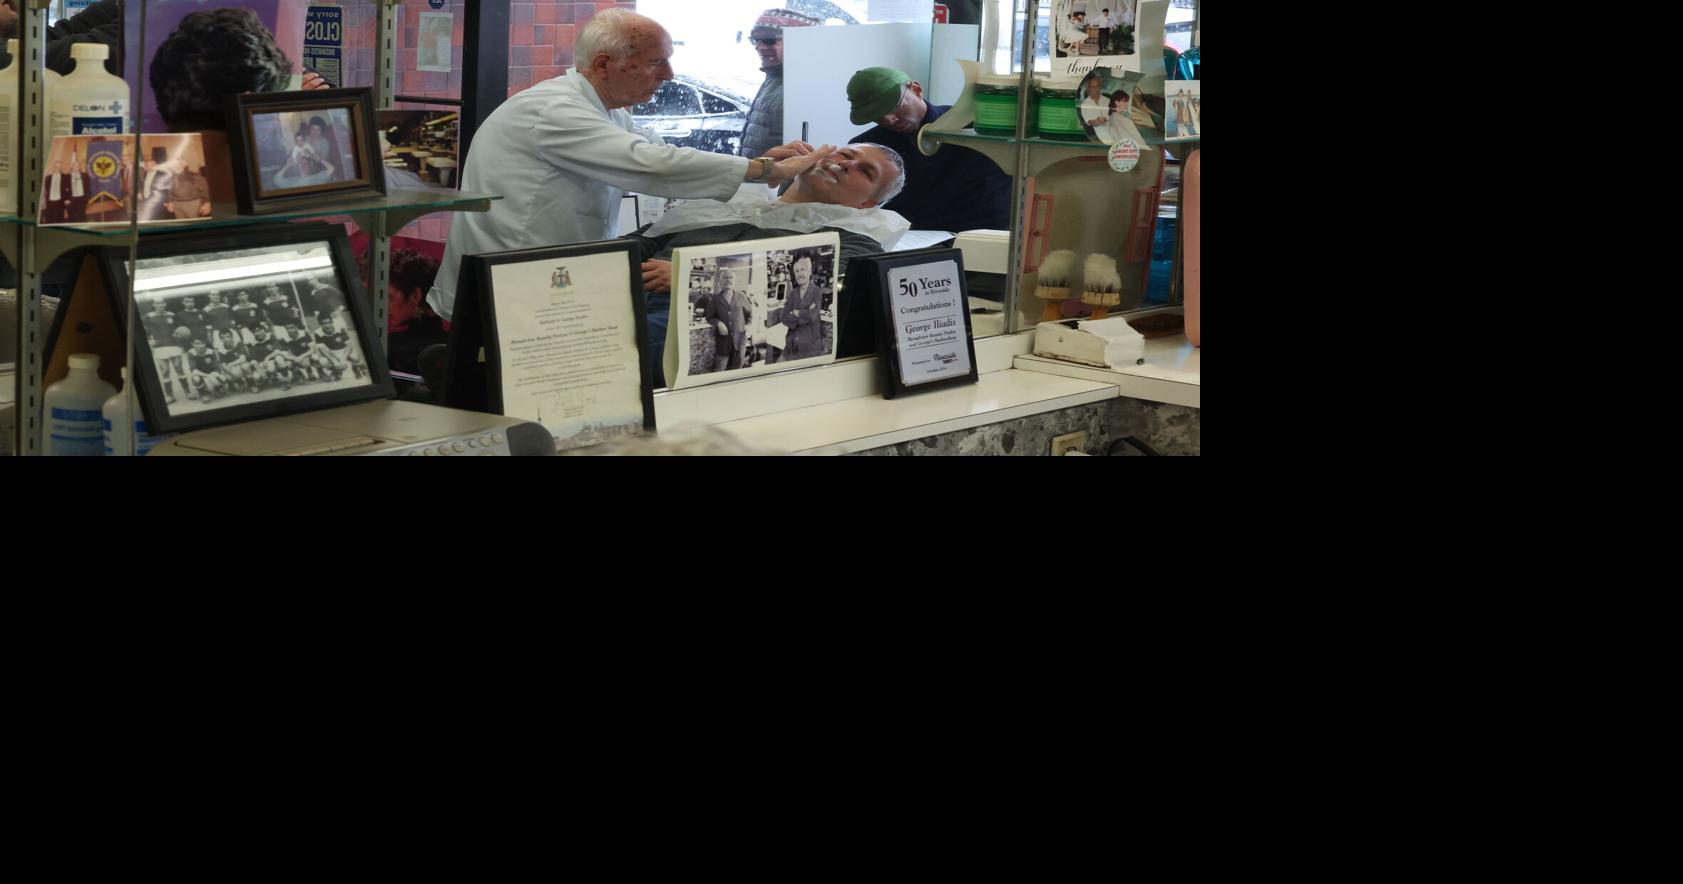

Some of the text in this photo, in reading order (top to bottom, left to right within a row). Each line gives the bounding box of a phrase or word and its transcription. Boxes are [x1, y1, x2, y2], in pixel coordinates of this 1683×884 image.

[81, 126, 117, 134] Alcohol
[900, 278, 952, 297] 50 Years
[901, 301, 952, 314] Congratulations
[905, 318, 956, 334] George Iliadis
